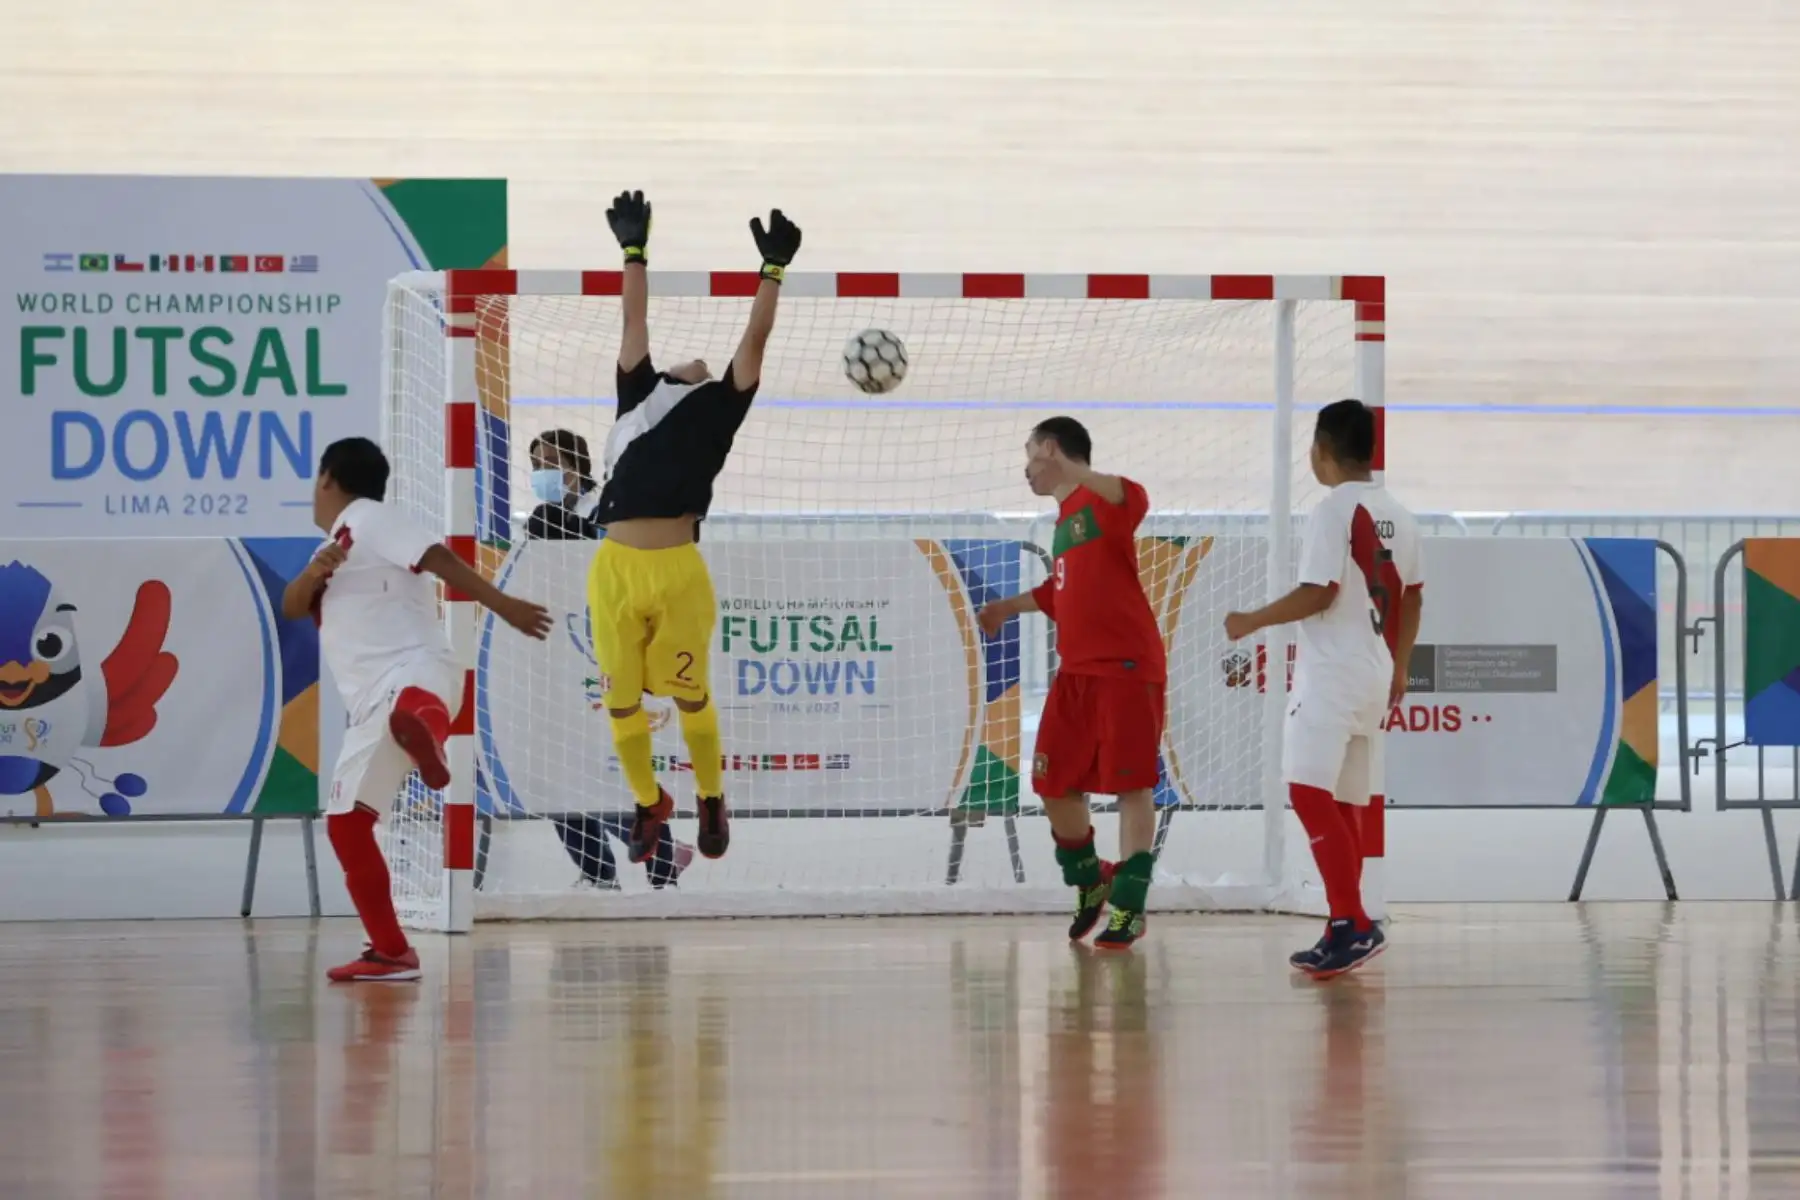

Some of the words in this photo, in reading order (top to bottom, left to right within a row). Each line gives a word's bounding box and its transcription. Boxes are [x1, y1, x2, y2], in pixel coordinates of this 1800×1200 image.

[17, 292, 114, 314] WORLD
[126, 292, 341, 315] CHAMPIONSHIP
[20, 326, 347, 397] FUTSAL
[51, 409, 313, 482] DOWN
[105, 494, 170, 516] LIMA
[183, 494, 249, 516] 2022
[720, 599, 770, 611] WORLD
[722, 615, 893, 653] FUTSAL
[675, 651, 695, 682] 2
[738, 658, 875, 696] DOWN
[1379, 704, 1462, 733] ADIS
